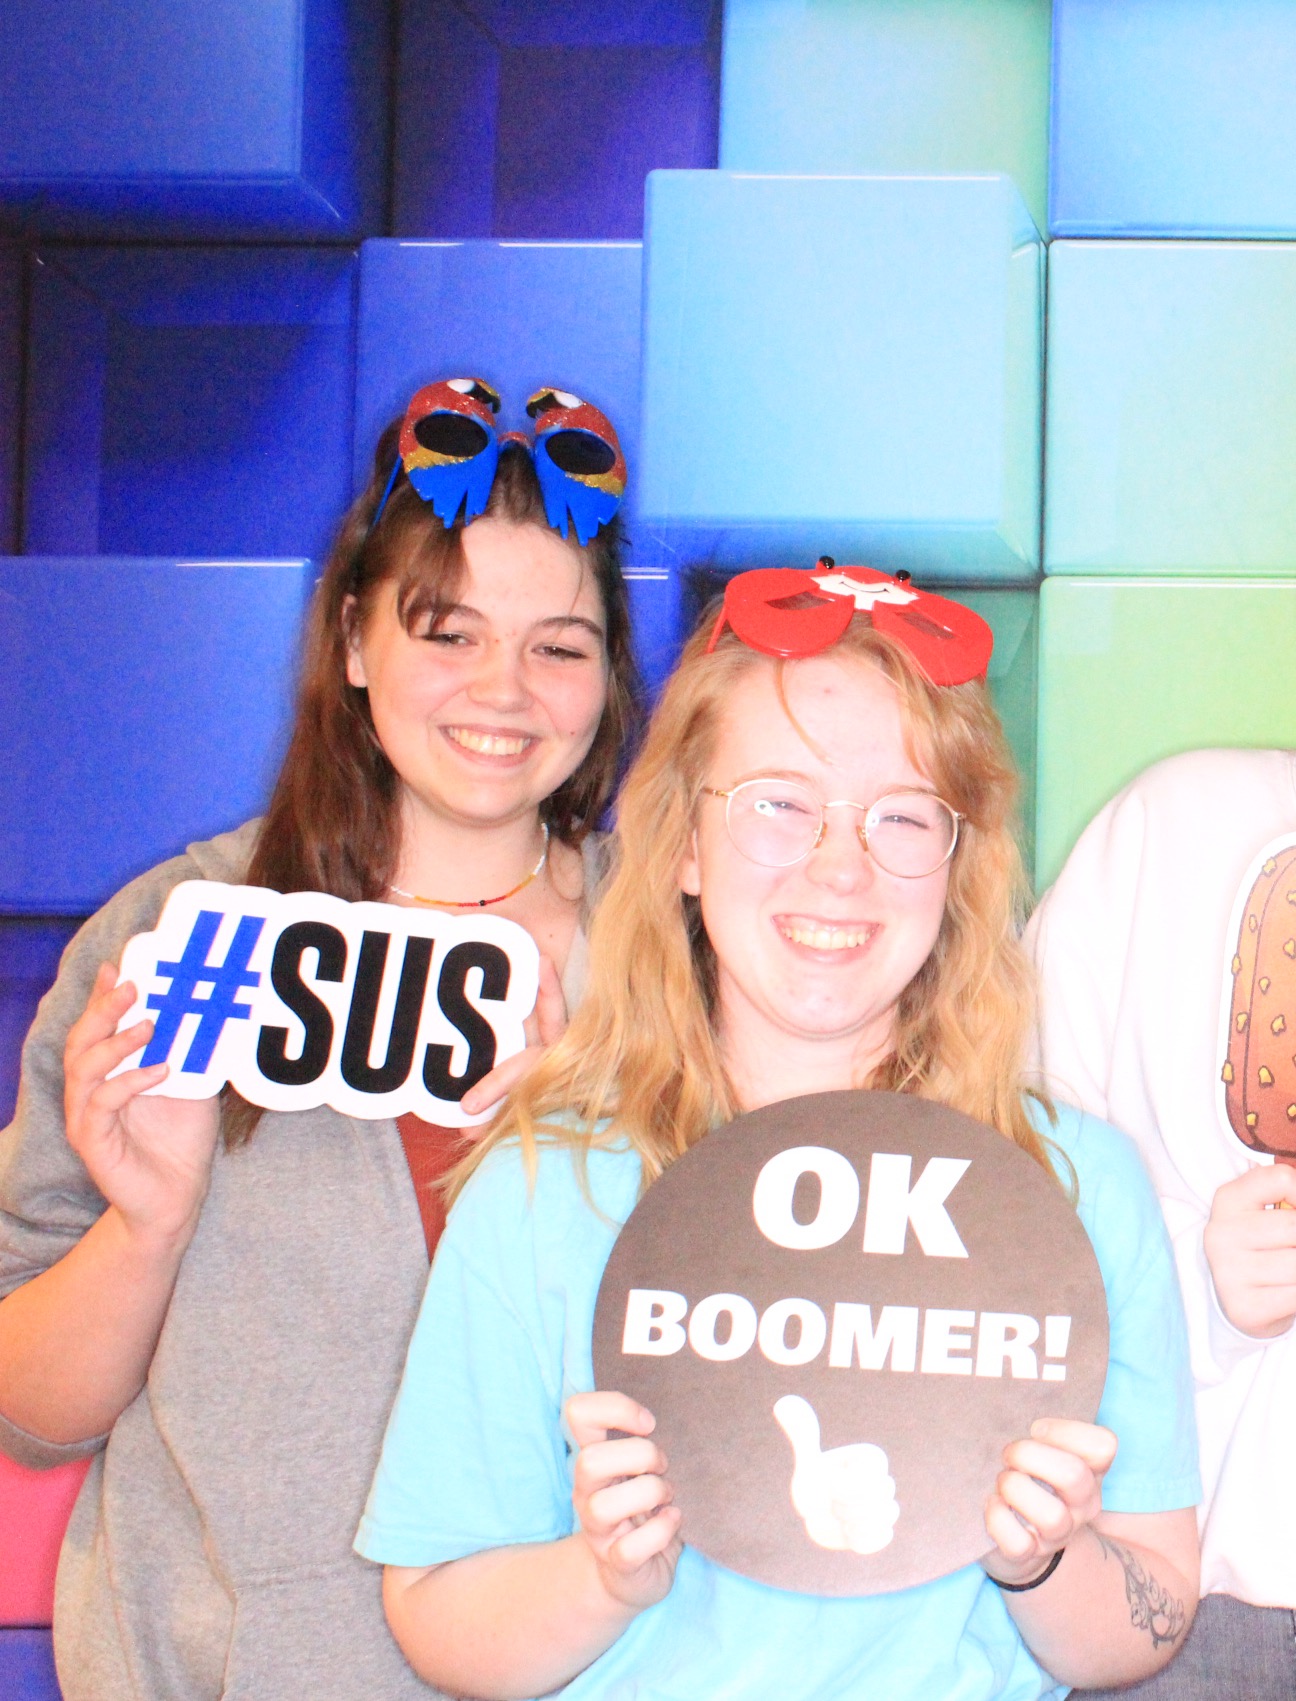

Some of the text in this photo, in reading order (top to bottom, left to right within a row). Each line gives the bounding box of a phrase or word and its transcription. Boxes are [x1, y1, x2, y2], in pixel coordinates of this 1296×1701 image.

[138, 909, 512, 1103] #SUS
[752, 1145, 972, 1259] OK
[621, 1288, 1072, 1381] BOOMER!
